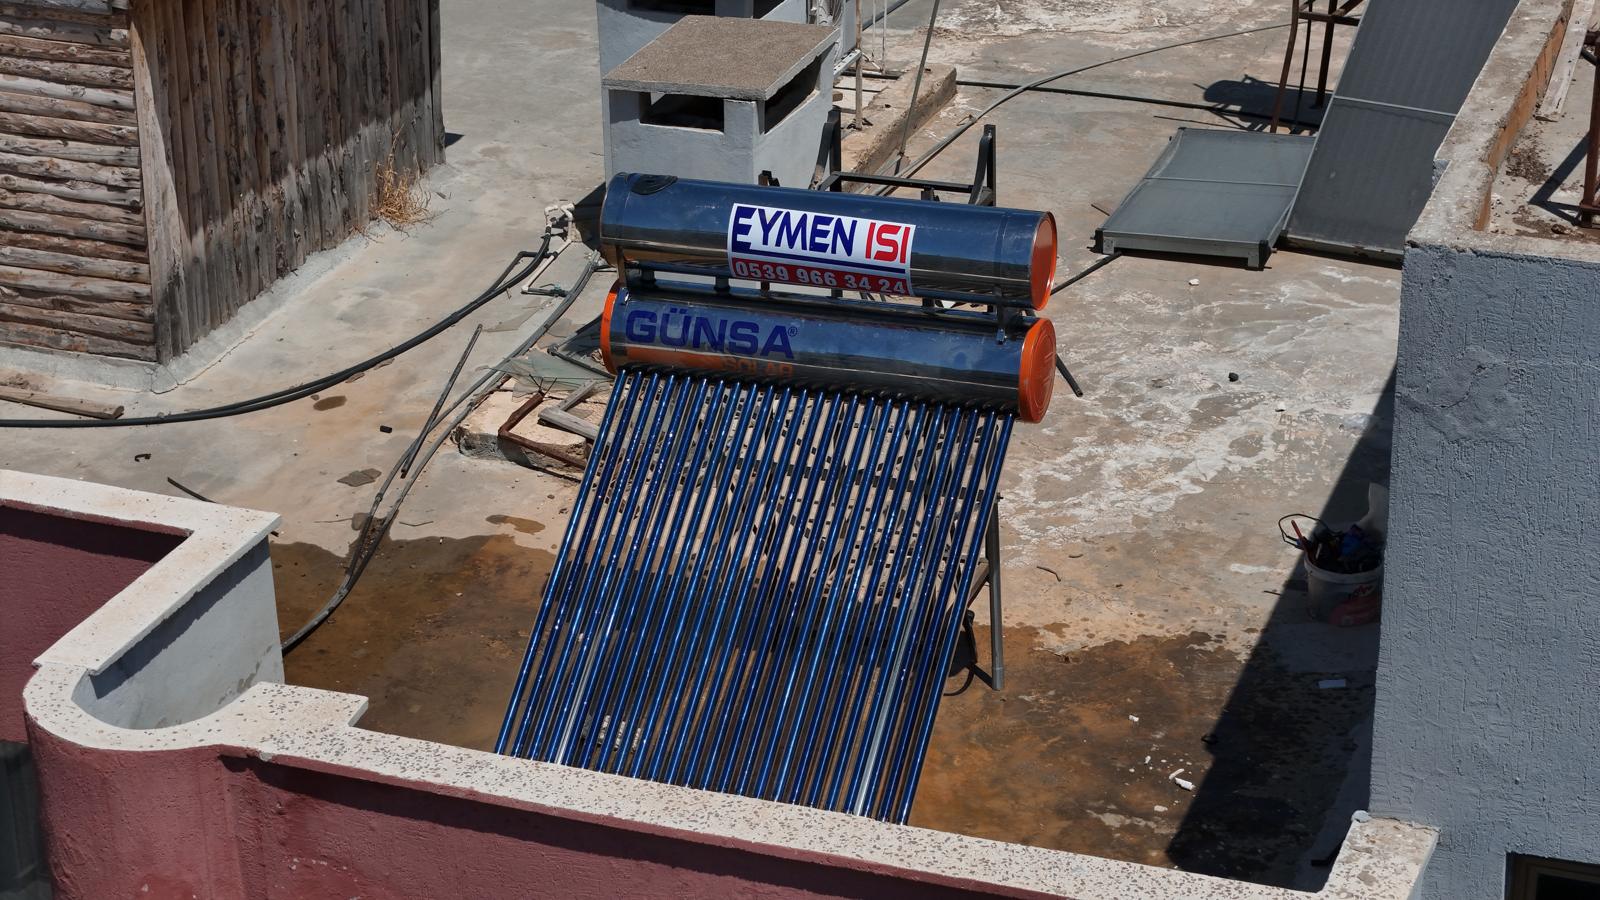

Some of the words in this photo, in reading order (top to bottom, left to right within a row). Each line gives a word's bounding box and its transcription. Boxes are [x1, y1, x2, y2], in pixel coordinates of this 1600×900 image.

[732, 206, 857, 257] EYMEN
[865, 222, 911, 264] ISI
[735, 261, 789, 281] 0539
[796, 269, 837, 286] 966
[844, 274, 872, 290] 34
[878, 278, 906, 294] 24
